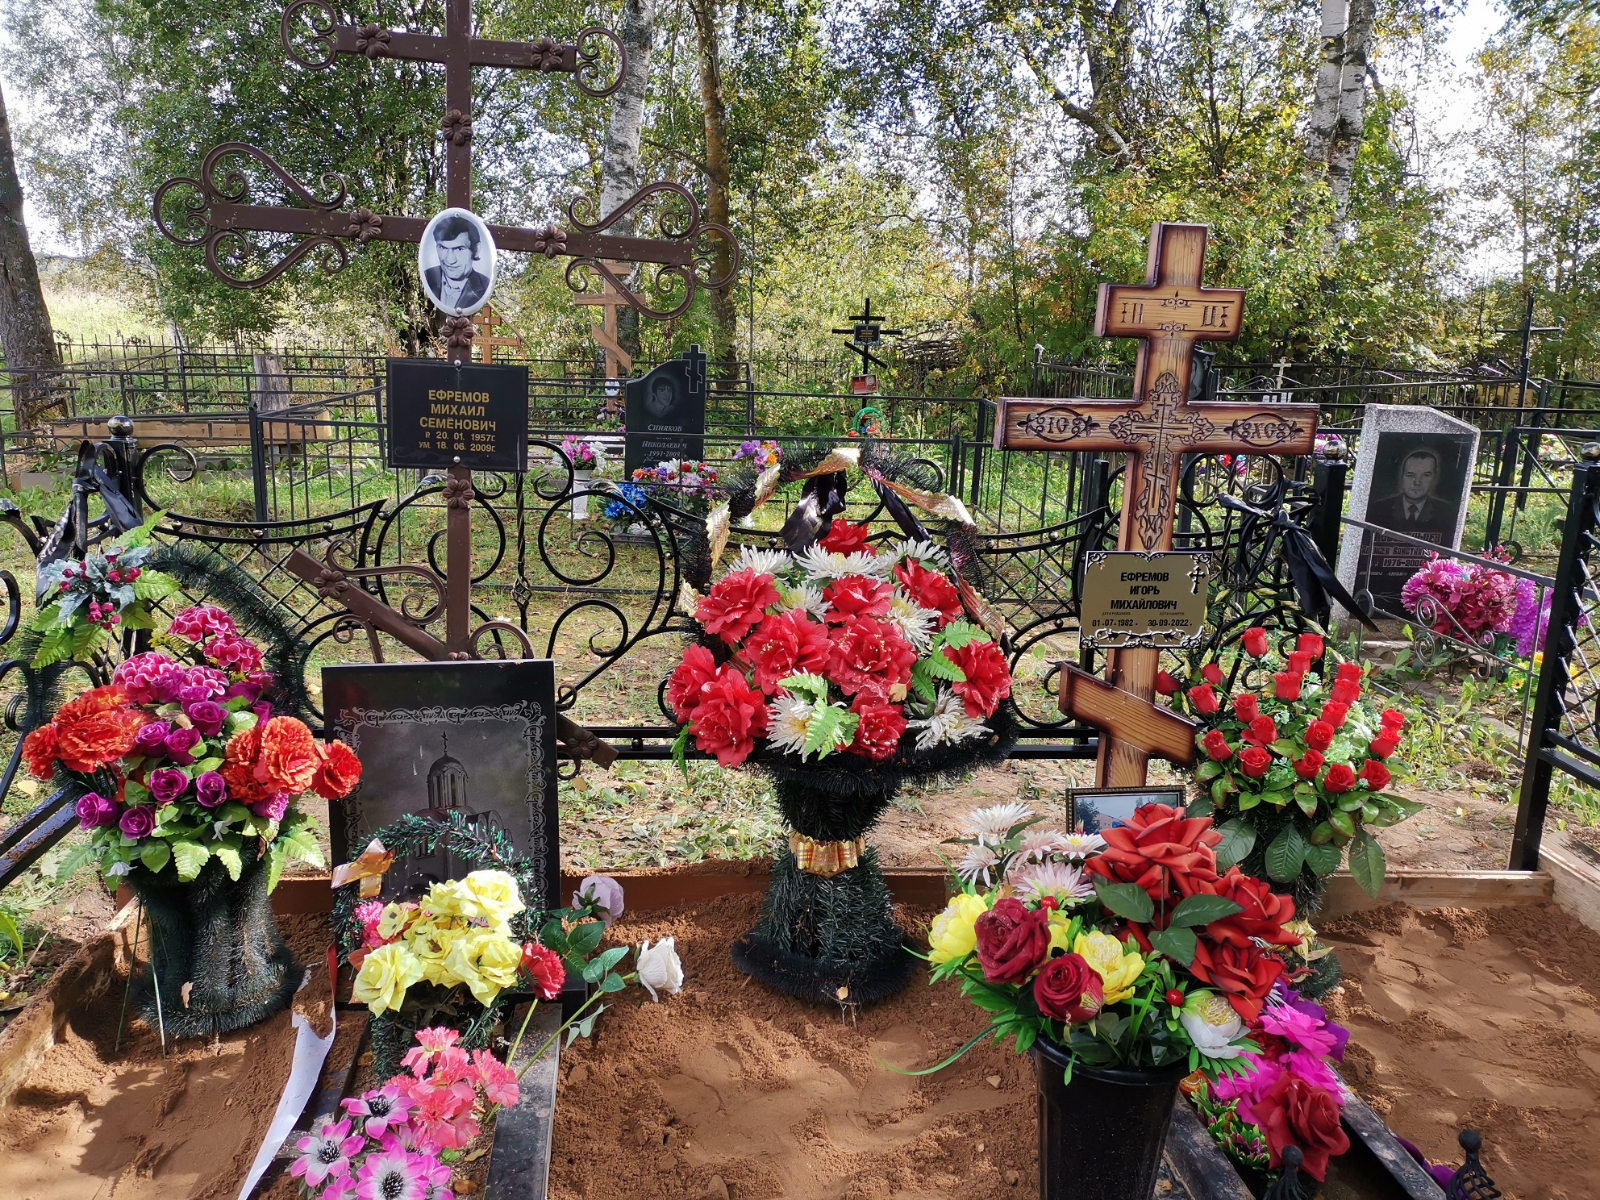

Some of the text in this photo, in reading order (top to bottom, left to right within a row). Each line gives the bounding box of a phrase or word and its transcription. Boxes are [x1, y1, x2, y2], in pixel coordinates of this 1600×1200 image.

[428, 389, 490, 403] ЕФРЕМОВ
[430, 403, 485, 417] МИХАИЛ
[419, 416, 496, 431] СЕМЁНОВИЧ
[435, 431, 449, 439] 20.
[453, 432, 465, 440] 01.
[436, 441, 448, 449] 18.
[1120, 572, 1169, 582] ЕФРЕМОВ
[1129, 585, 1160, 595] ИГОРЬ
[1110, 598, 1178, 610] МИХАЙЛОВИЧ
